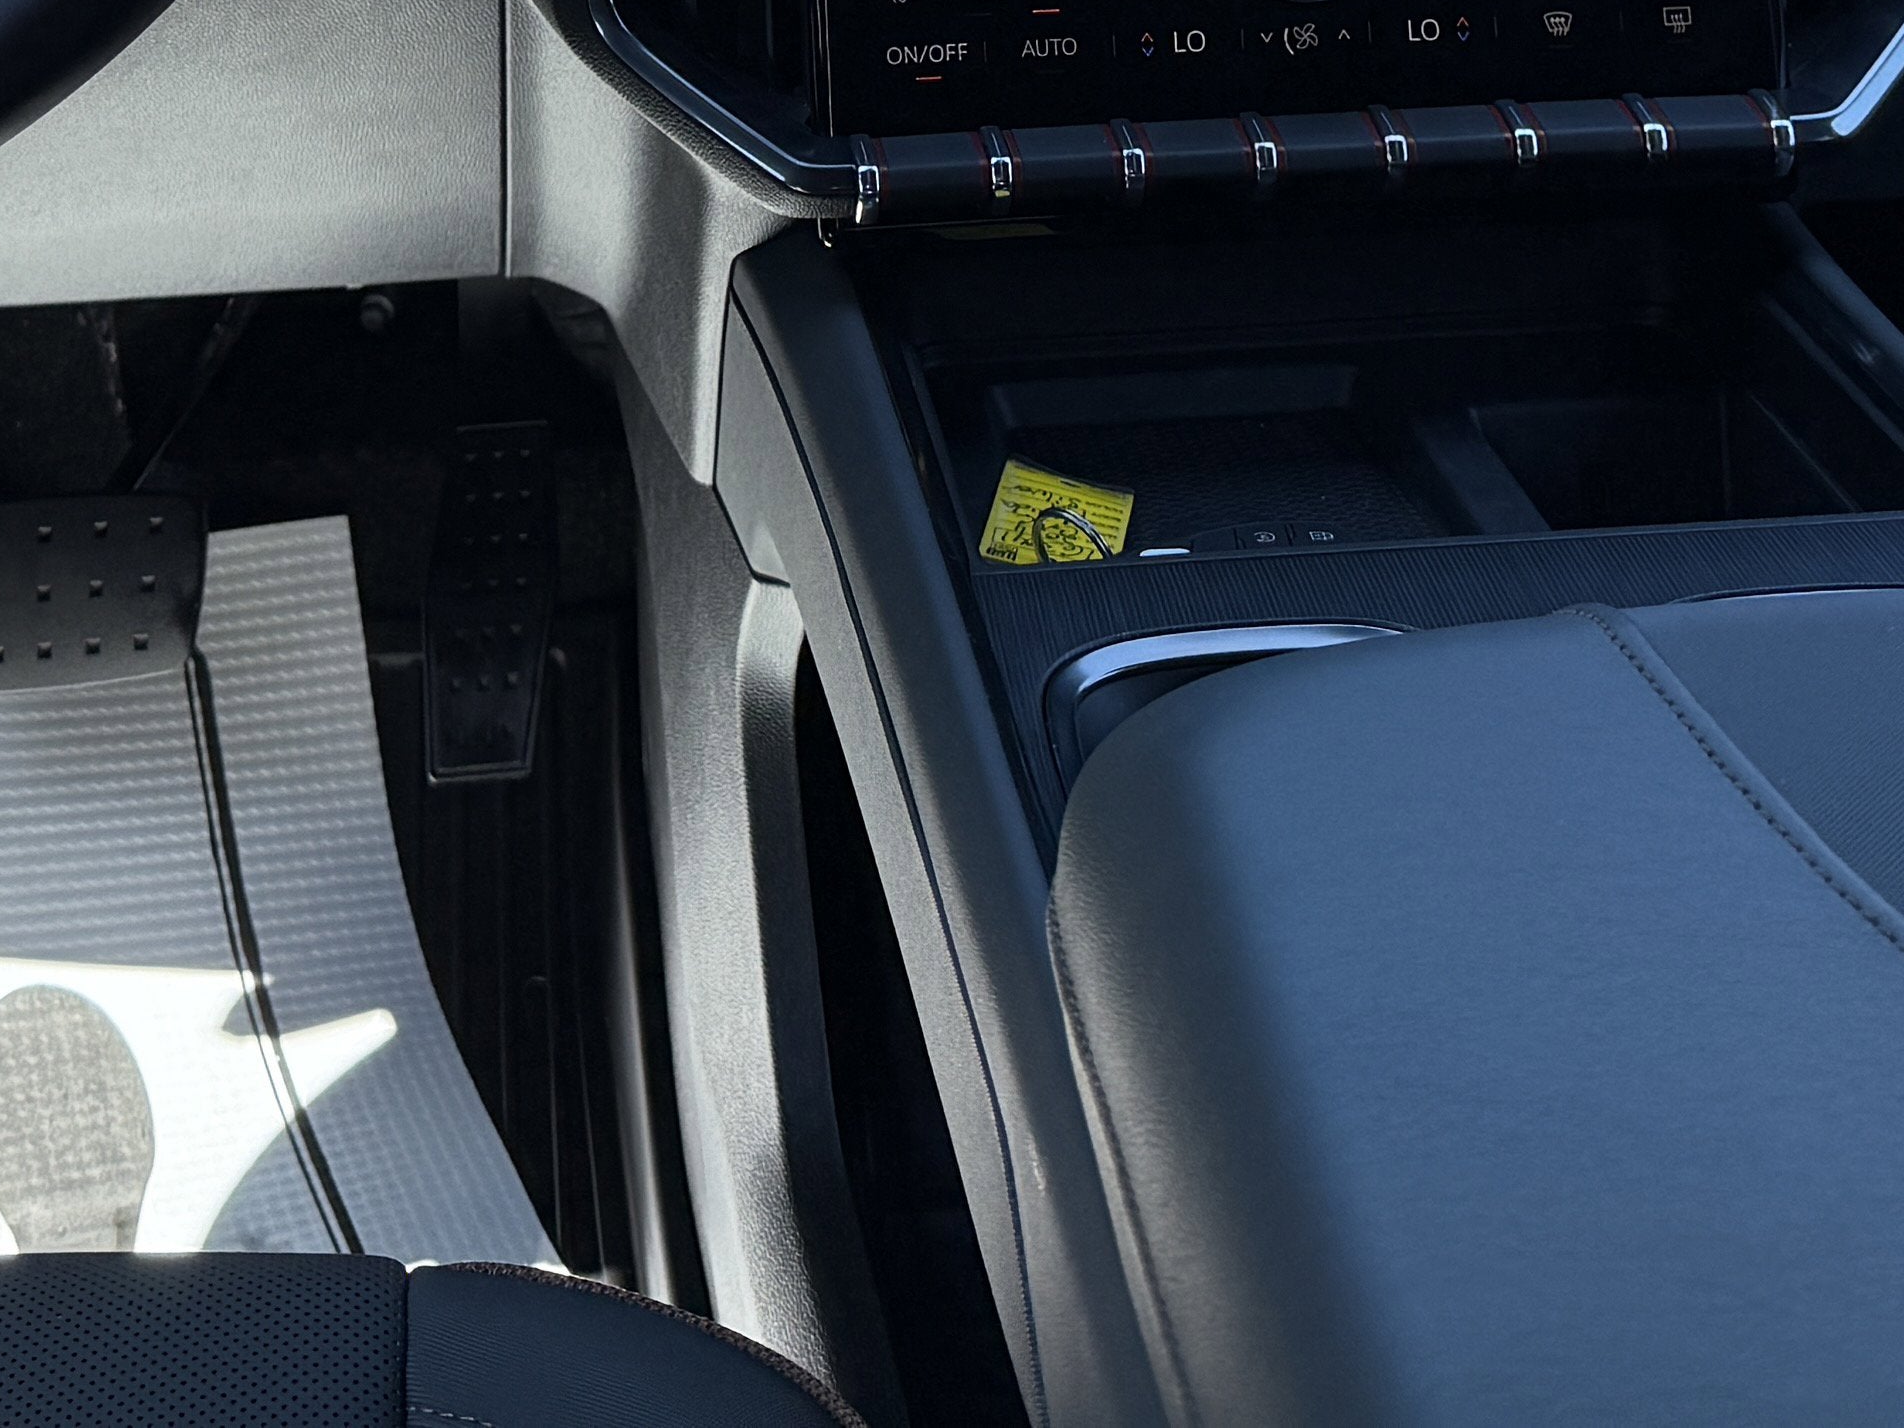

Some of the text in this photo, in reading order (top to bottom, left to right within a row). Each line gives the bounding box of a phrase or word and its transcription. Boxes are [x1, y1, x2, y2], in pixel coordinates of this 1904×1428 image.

[1173, 30, 1206, 54] LO
[1408, 18, 1440, 42] LO
[886, 42, 969, 66] ON/OFF
[1021, 37, 1078, 59] AUTO
